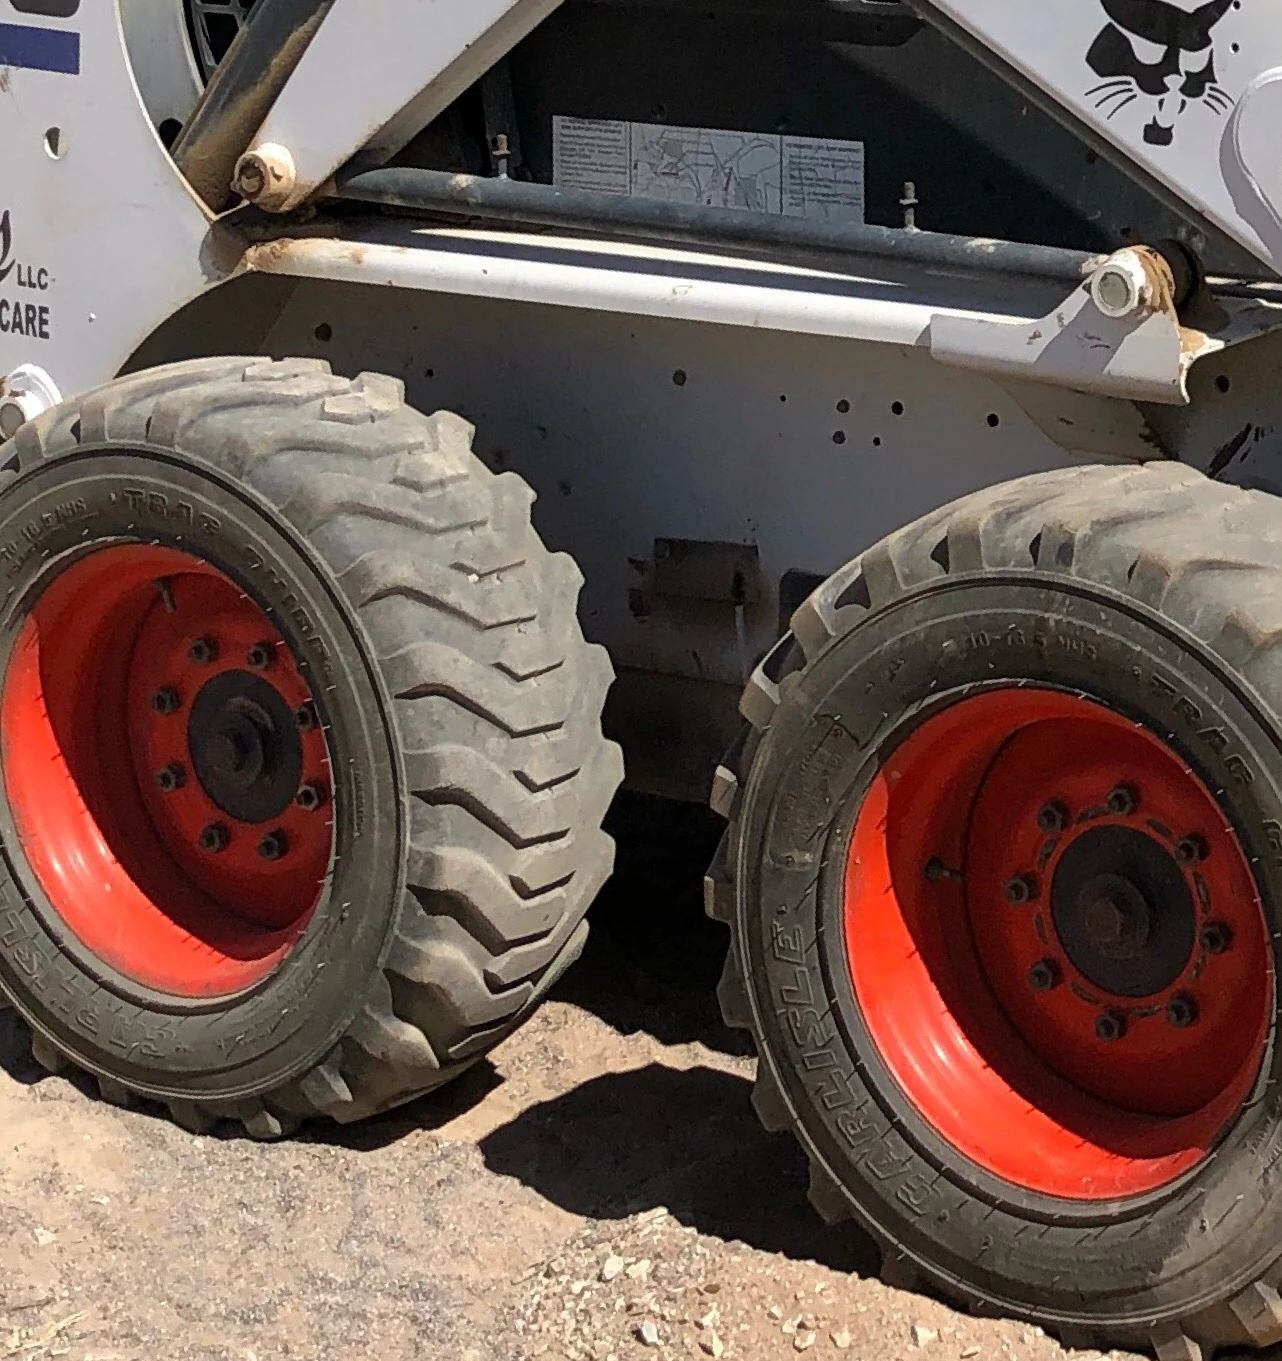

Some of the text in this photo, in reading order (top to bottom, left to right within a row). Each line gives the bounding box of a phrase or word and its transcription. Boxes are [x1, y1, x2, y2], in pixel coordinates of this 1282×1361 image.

[17, 263, 49, 290] LLC
[0, 298, 50, 340] CARE
[1150, 672, 1256, 787] TRAC
[769, 918, 940, 1224] CARLISLE
